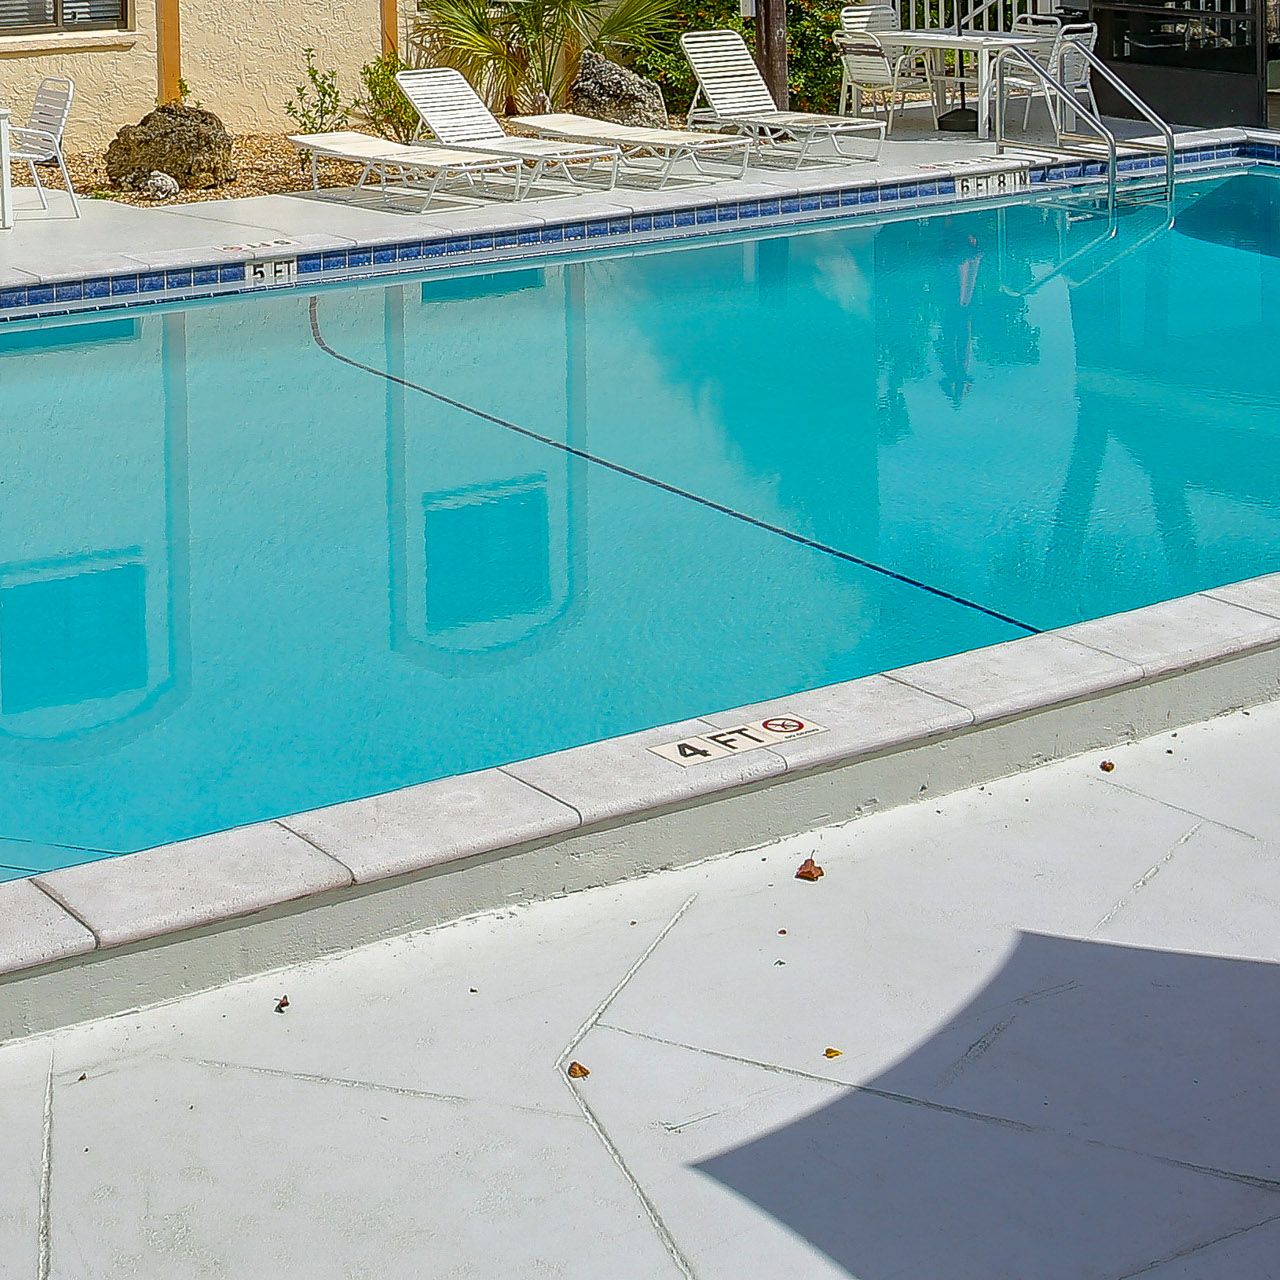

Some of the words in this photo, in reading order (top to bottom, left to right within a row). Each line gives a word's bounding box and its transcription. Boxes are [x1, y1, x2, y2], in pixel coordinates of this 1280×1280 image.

[961, 178, 970, 194] 6
[976, 176, 990, 191] FT
[998, 173, 1006, 188] 8
[1013, 170, 1027, 186] IN
[252, 263, 265, 281] 5
[273, 260, 295, 278] FT
[677, 743, 712, 758] 4
[707, 728, 764, 750] FT
